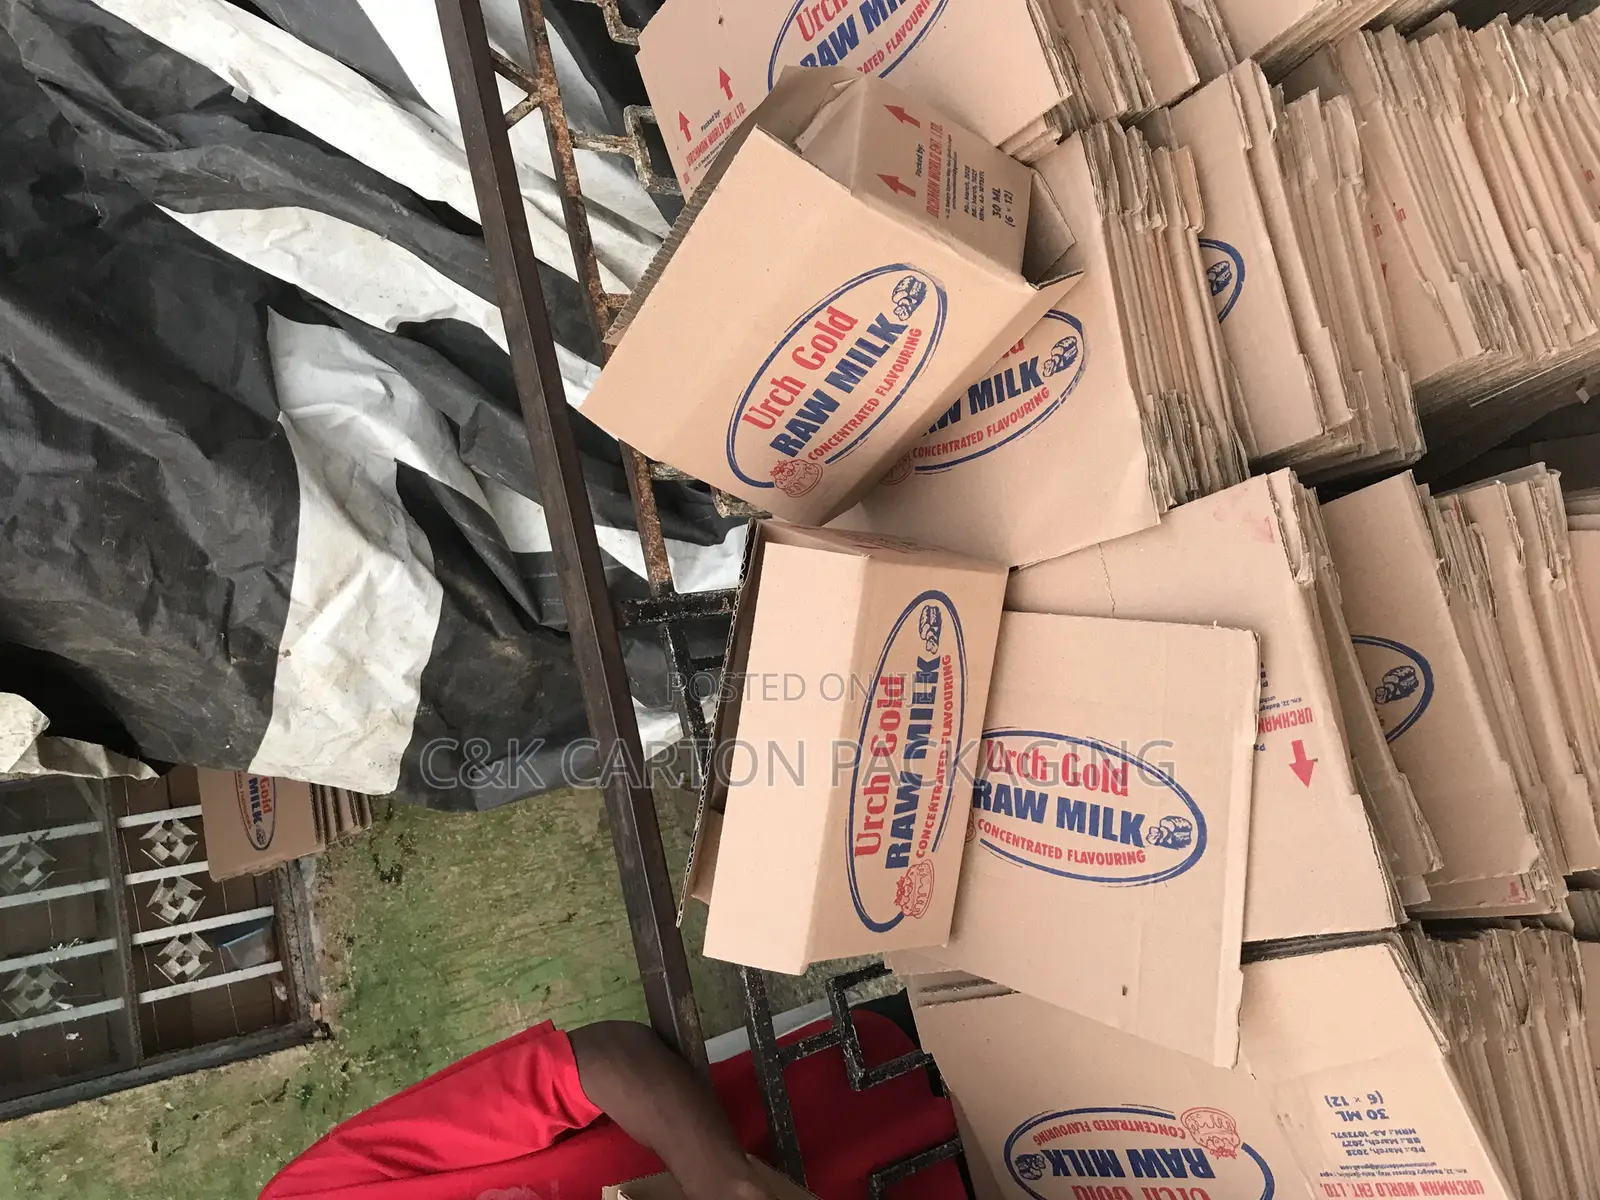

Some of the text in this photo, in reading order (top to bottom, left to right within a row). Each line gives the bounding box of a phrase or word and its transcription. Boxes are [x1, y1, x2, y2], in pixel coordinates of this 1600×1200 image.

[707, 122, 725, 146] WORLD
[723, 112, 736, 131] ENT.
[734, 101, 747, 119] LTD.
[930, 121, 943, 138] LTD.
[930, 137, 942, 155] ENT.
[915, 154, 923, 178] Packed
[928, 153, 942, 181] WORLD
[992, 187, 1001, 219] 30 ML
[1005, 215, 1016, 228] (6
[742, 305, 858, 429] Urch Gold
[769, 312, 909, 457] RAW MILK
[807, 328, 922, 461] CONCENTRATED FLAVOURING
[967, 355, 1044, 415] MILK
[912, 430, 984, 459] CONCENTRATED
[985, 386, 1050, 438] FLAVOURING
[1258, 707, 1313, 735] URCHMAN
[854, 676, 905, 858] Urch Gold
[885, 655, 942, 870] RAW MILK
[915, 654, 954, 859] CONCENTRATED FLAVOURING
[986, 740, 1129, 797] Urch Gold
[248, 777, 263, 825] MILK
[260, 776, 272, 814] Gold
[972, 778, 1146, 848] RAW MILK
[978, 818, 1146, 867] CONCENTRATED FLAVOURING
[1324, 1095, 1349, 1108] 12)
[1367, 1090, 1384, 1105] (6
[1335, 1108, 1389, 1122] 30 ML
[1033, 1119, 1186, 1146] CONCENTRATED FLAVOURING
[1365, 1138, 1399, 1146] March,
[1040, 1148, 1216, 1179] RAW MILK
[1369, 1147, 1403, 1155] March,
[1319, 1179, 1485, 1199] URCHMAN WORLD ENT. LTD.
